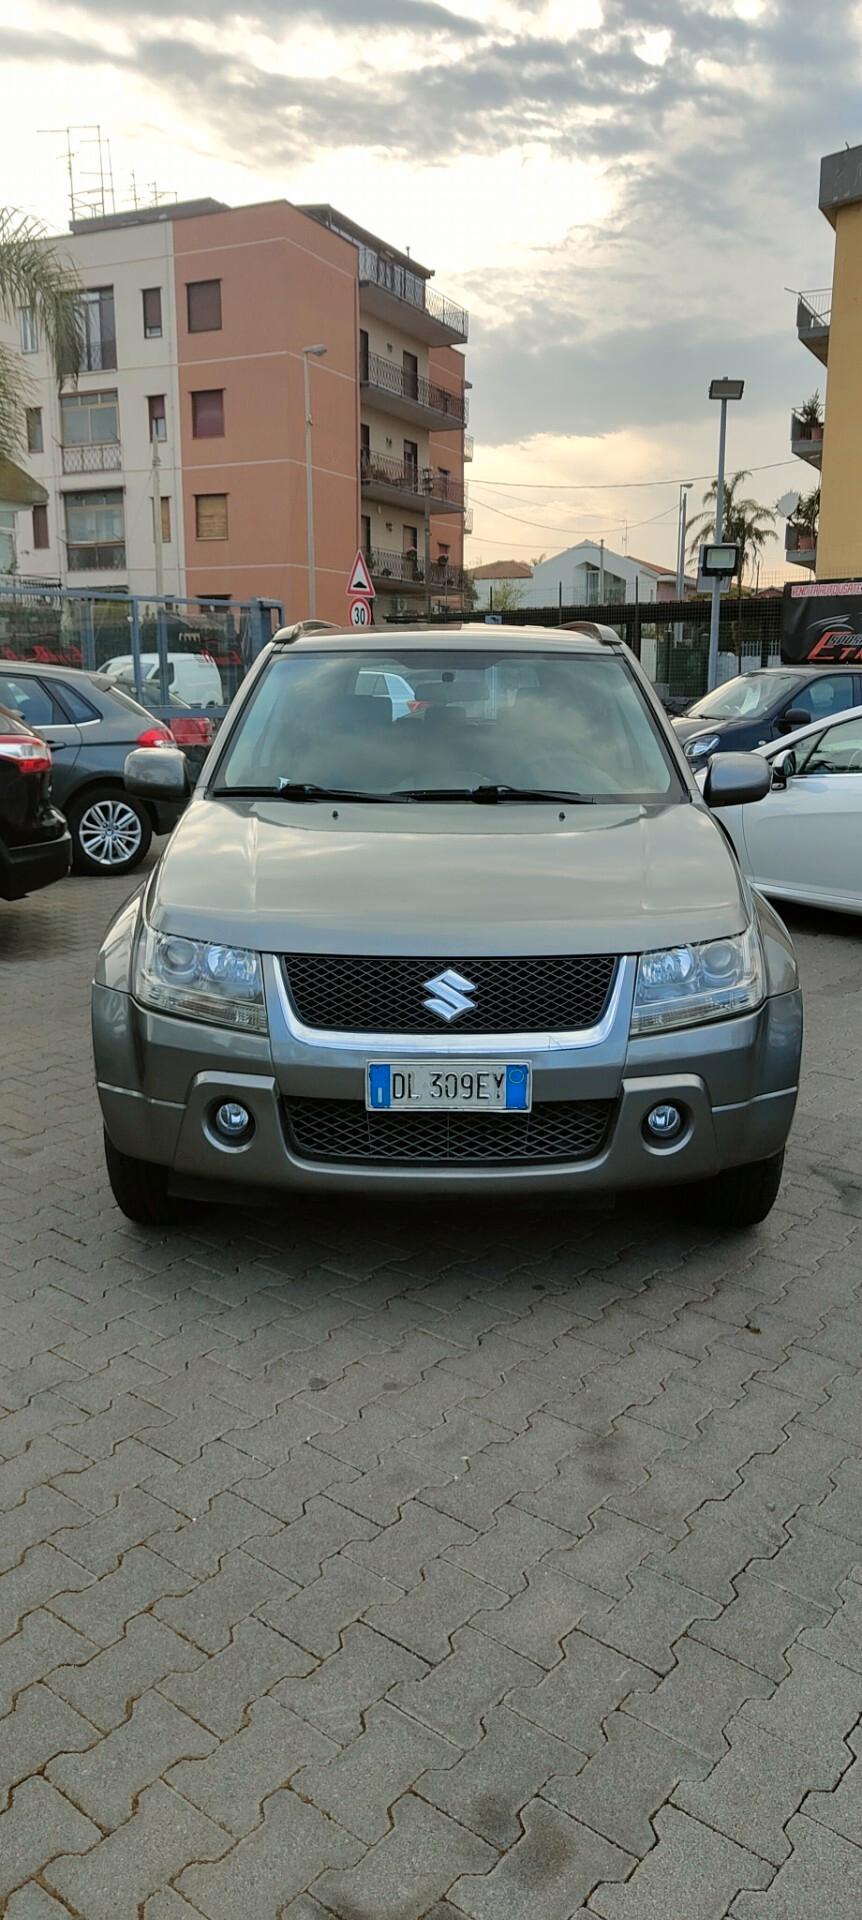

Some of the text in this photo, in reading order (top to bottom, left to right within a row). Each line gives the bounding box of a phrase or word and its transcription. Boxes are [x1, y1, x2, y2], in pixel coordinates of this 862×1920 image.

[354, 606, 366, 625] 30
[392, 1071, 505, 1100] DL 309EY
